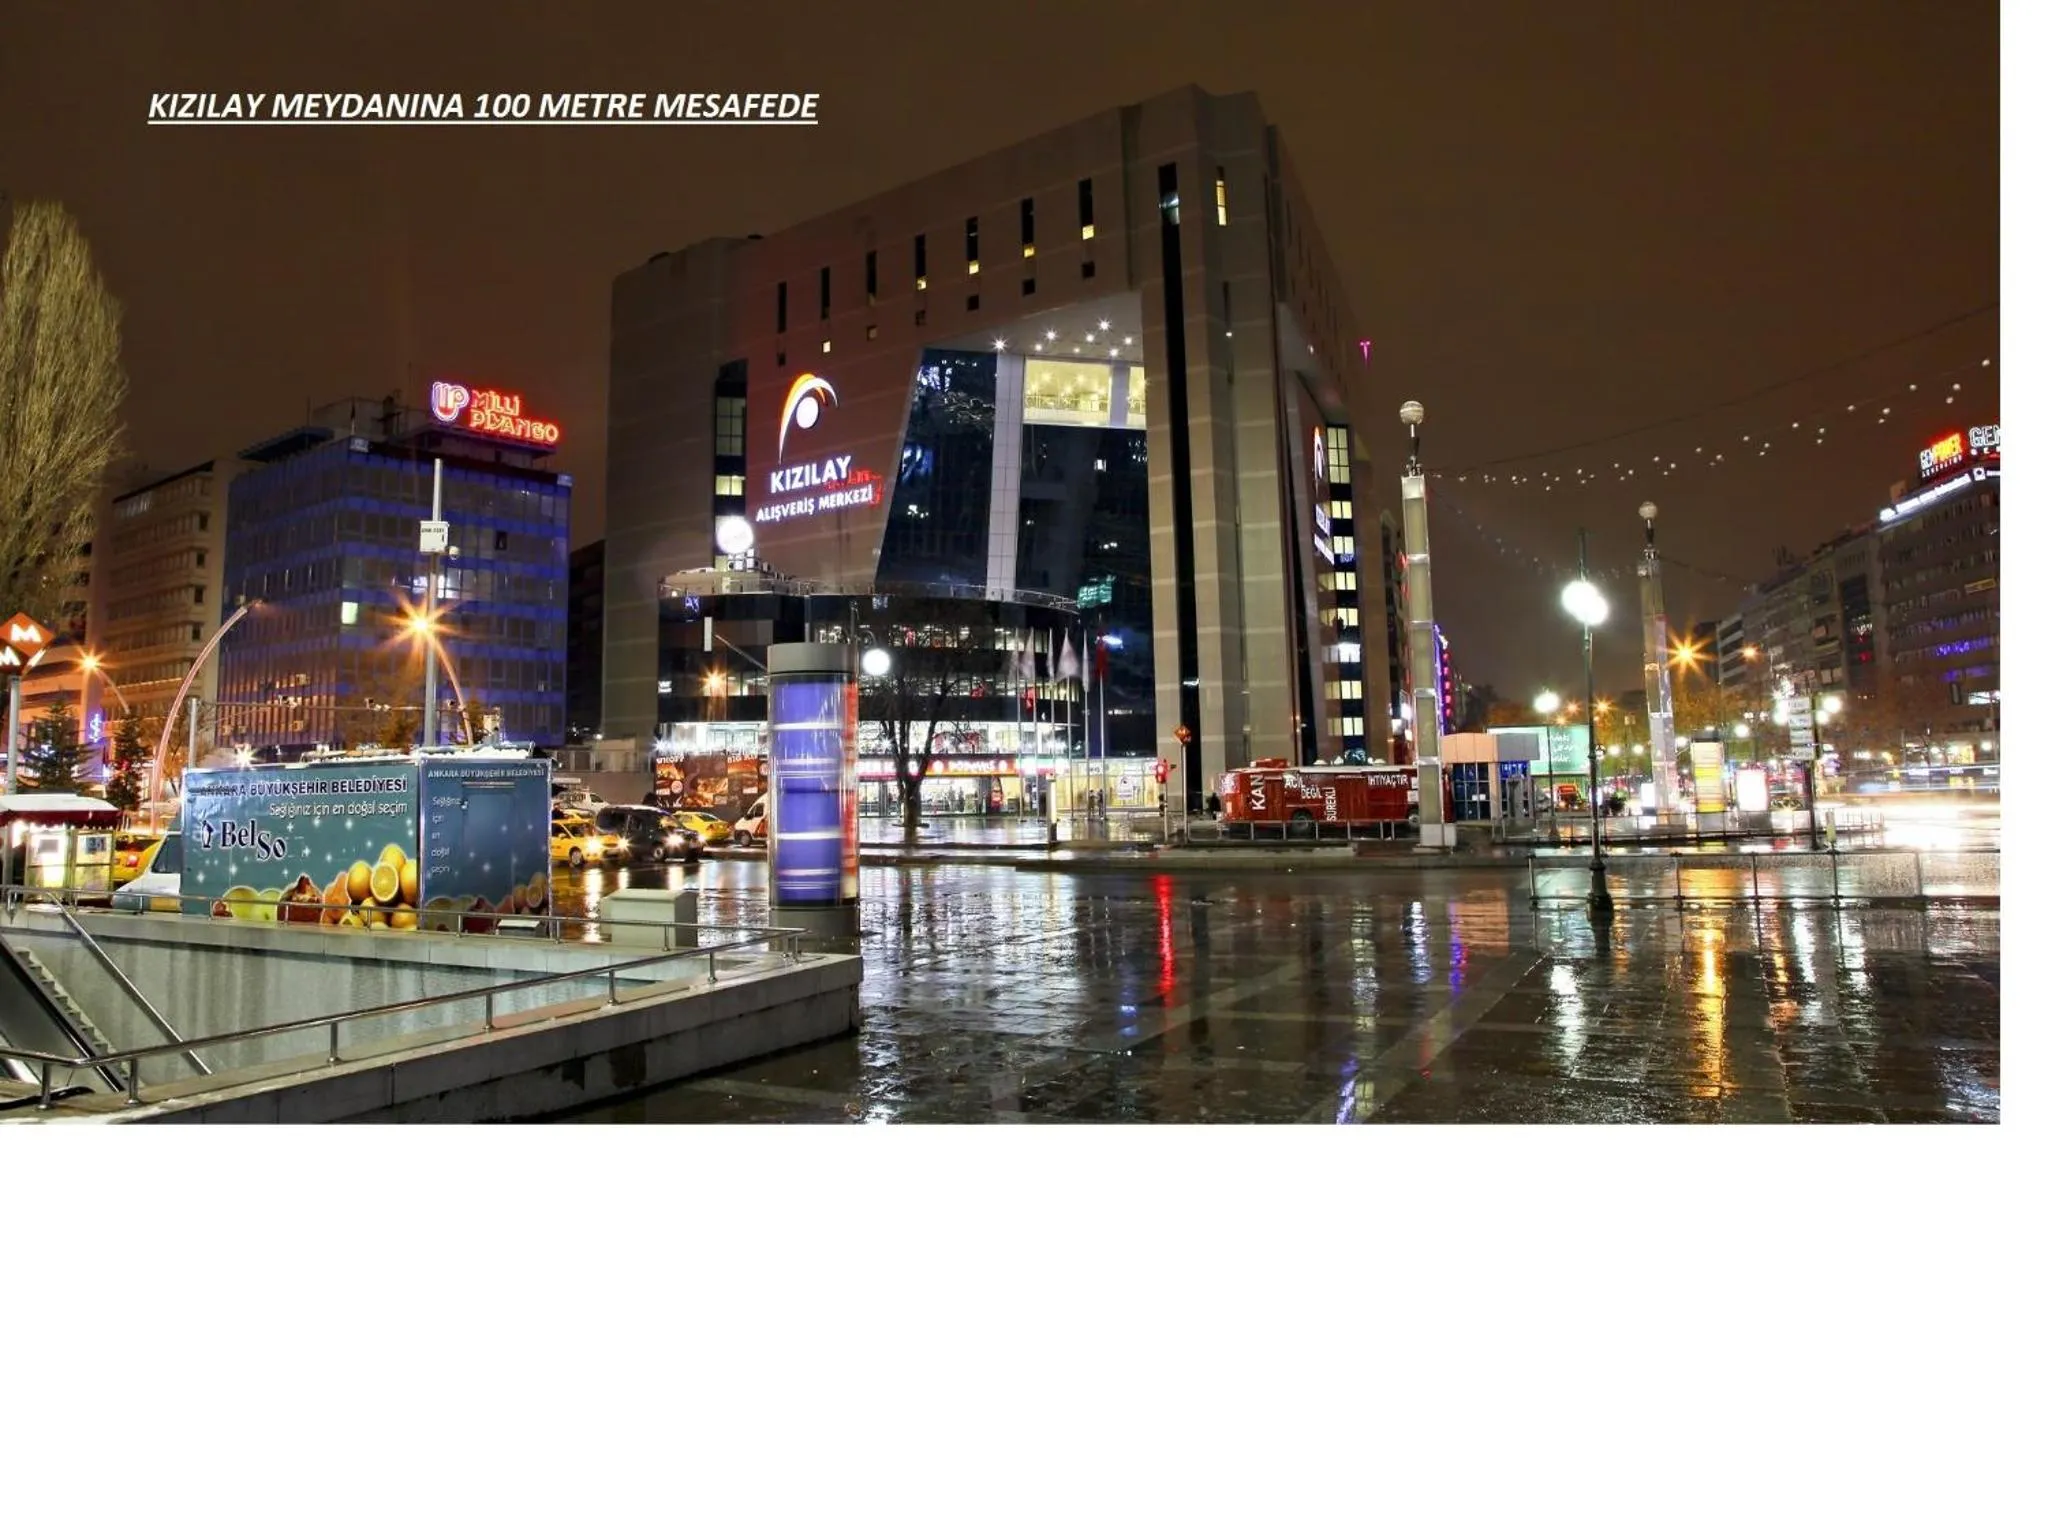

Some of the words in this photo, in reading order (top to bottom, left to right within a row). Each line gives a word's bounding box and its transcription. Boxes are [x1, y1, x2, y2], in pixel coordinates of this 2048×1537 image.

[770, 455, 851, 494] KIZILAY
[756, 497, 815, 522] ALIŞVERİŞ
[818, 483, 873, 511] MERKEZİ
[10, 623, 42, 643] M
[250, 778, 328, 799] BÜYÜKŞEHİR
[331, 776, 408, 794] BELEDİYESİ
[1251, 774, 1267, 811] KAN
[332, 805, 346, 814] en
[347, 801, 375, 817] doğal
[378, 801, 408, 817] seçim
